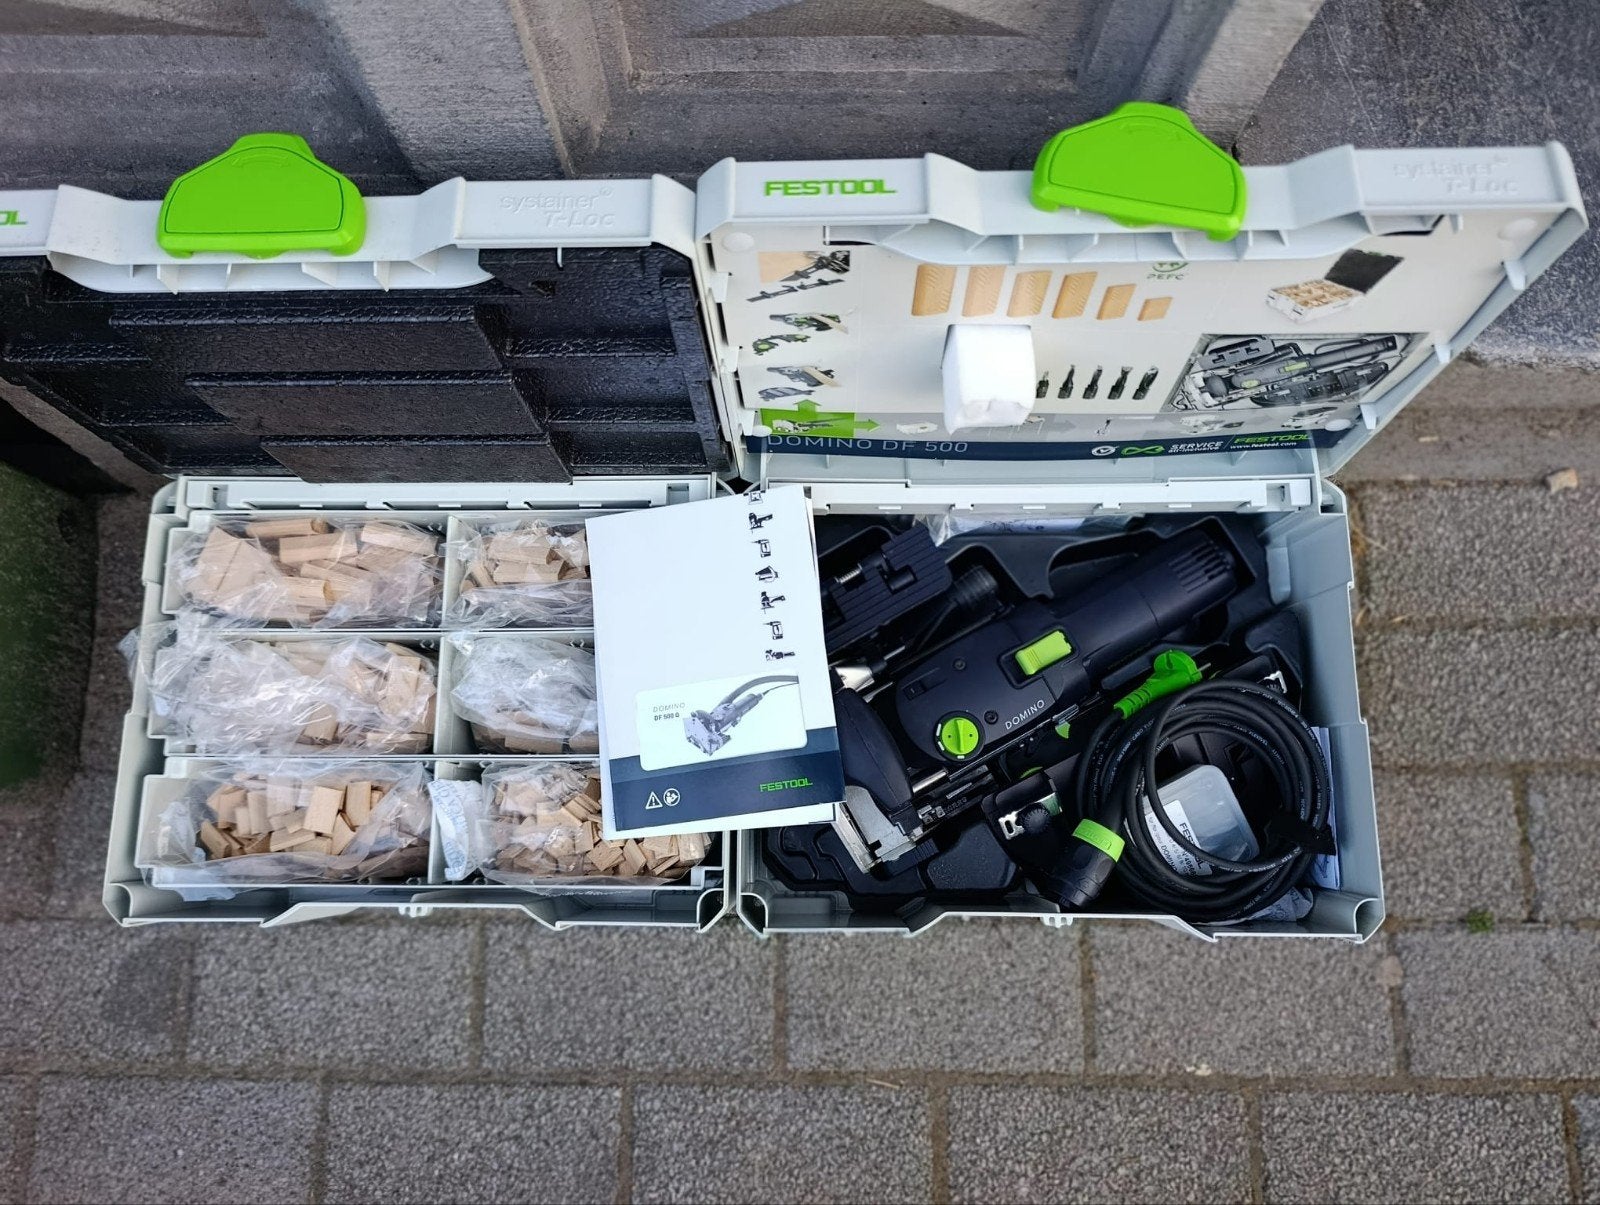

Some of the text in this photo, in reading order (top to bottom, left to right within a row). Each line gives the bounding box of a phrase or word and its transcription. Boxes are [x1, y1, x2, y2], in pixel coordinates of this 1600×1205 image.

[763, 179, 897, 196] FESTOOL
[767, 435, 969, 453] DOMINO DF 500
[1170, 441, 1223, 450] SERVICE
[1233, 434, 1310, 444] FESTOOL
[652, 702, 686, 713] DOMINO
[1005, 699, 1045, 730] DOMINO
[759, 777, 814, 793] FESTOOL
